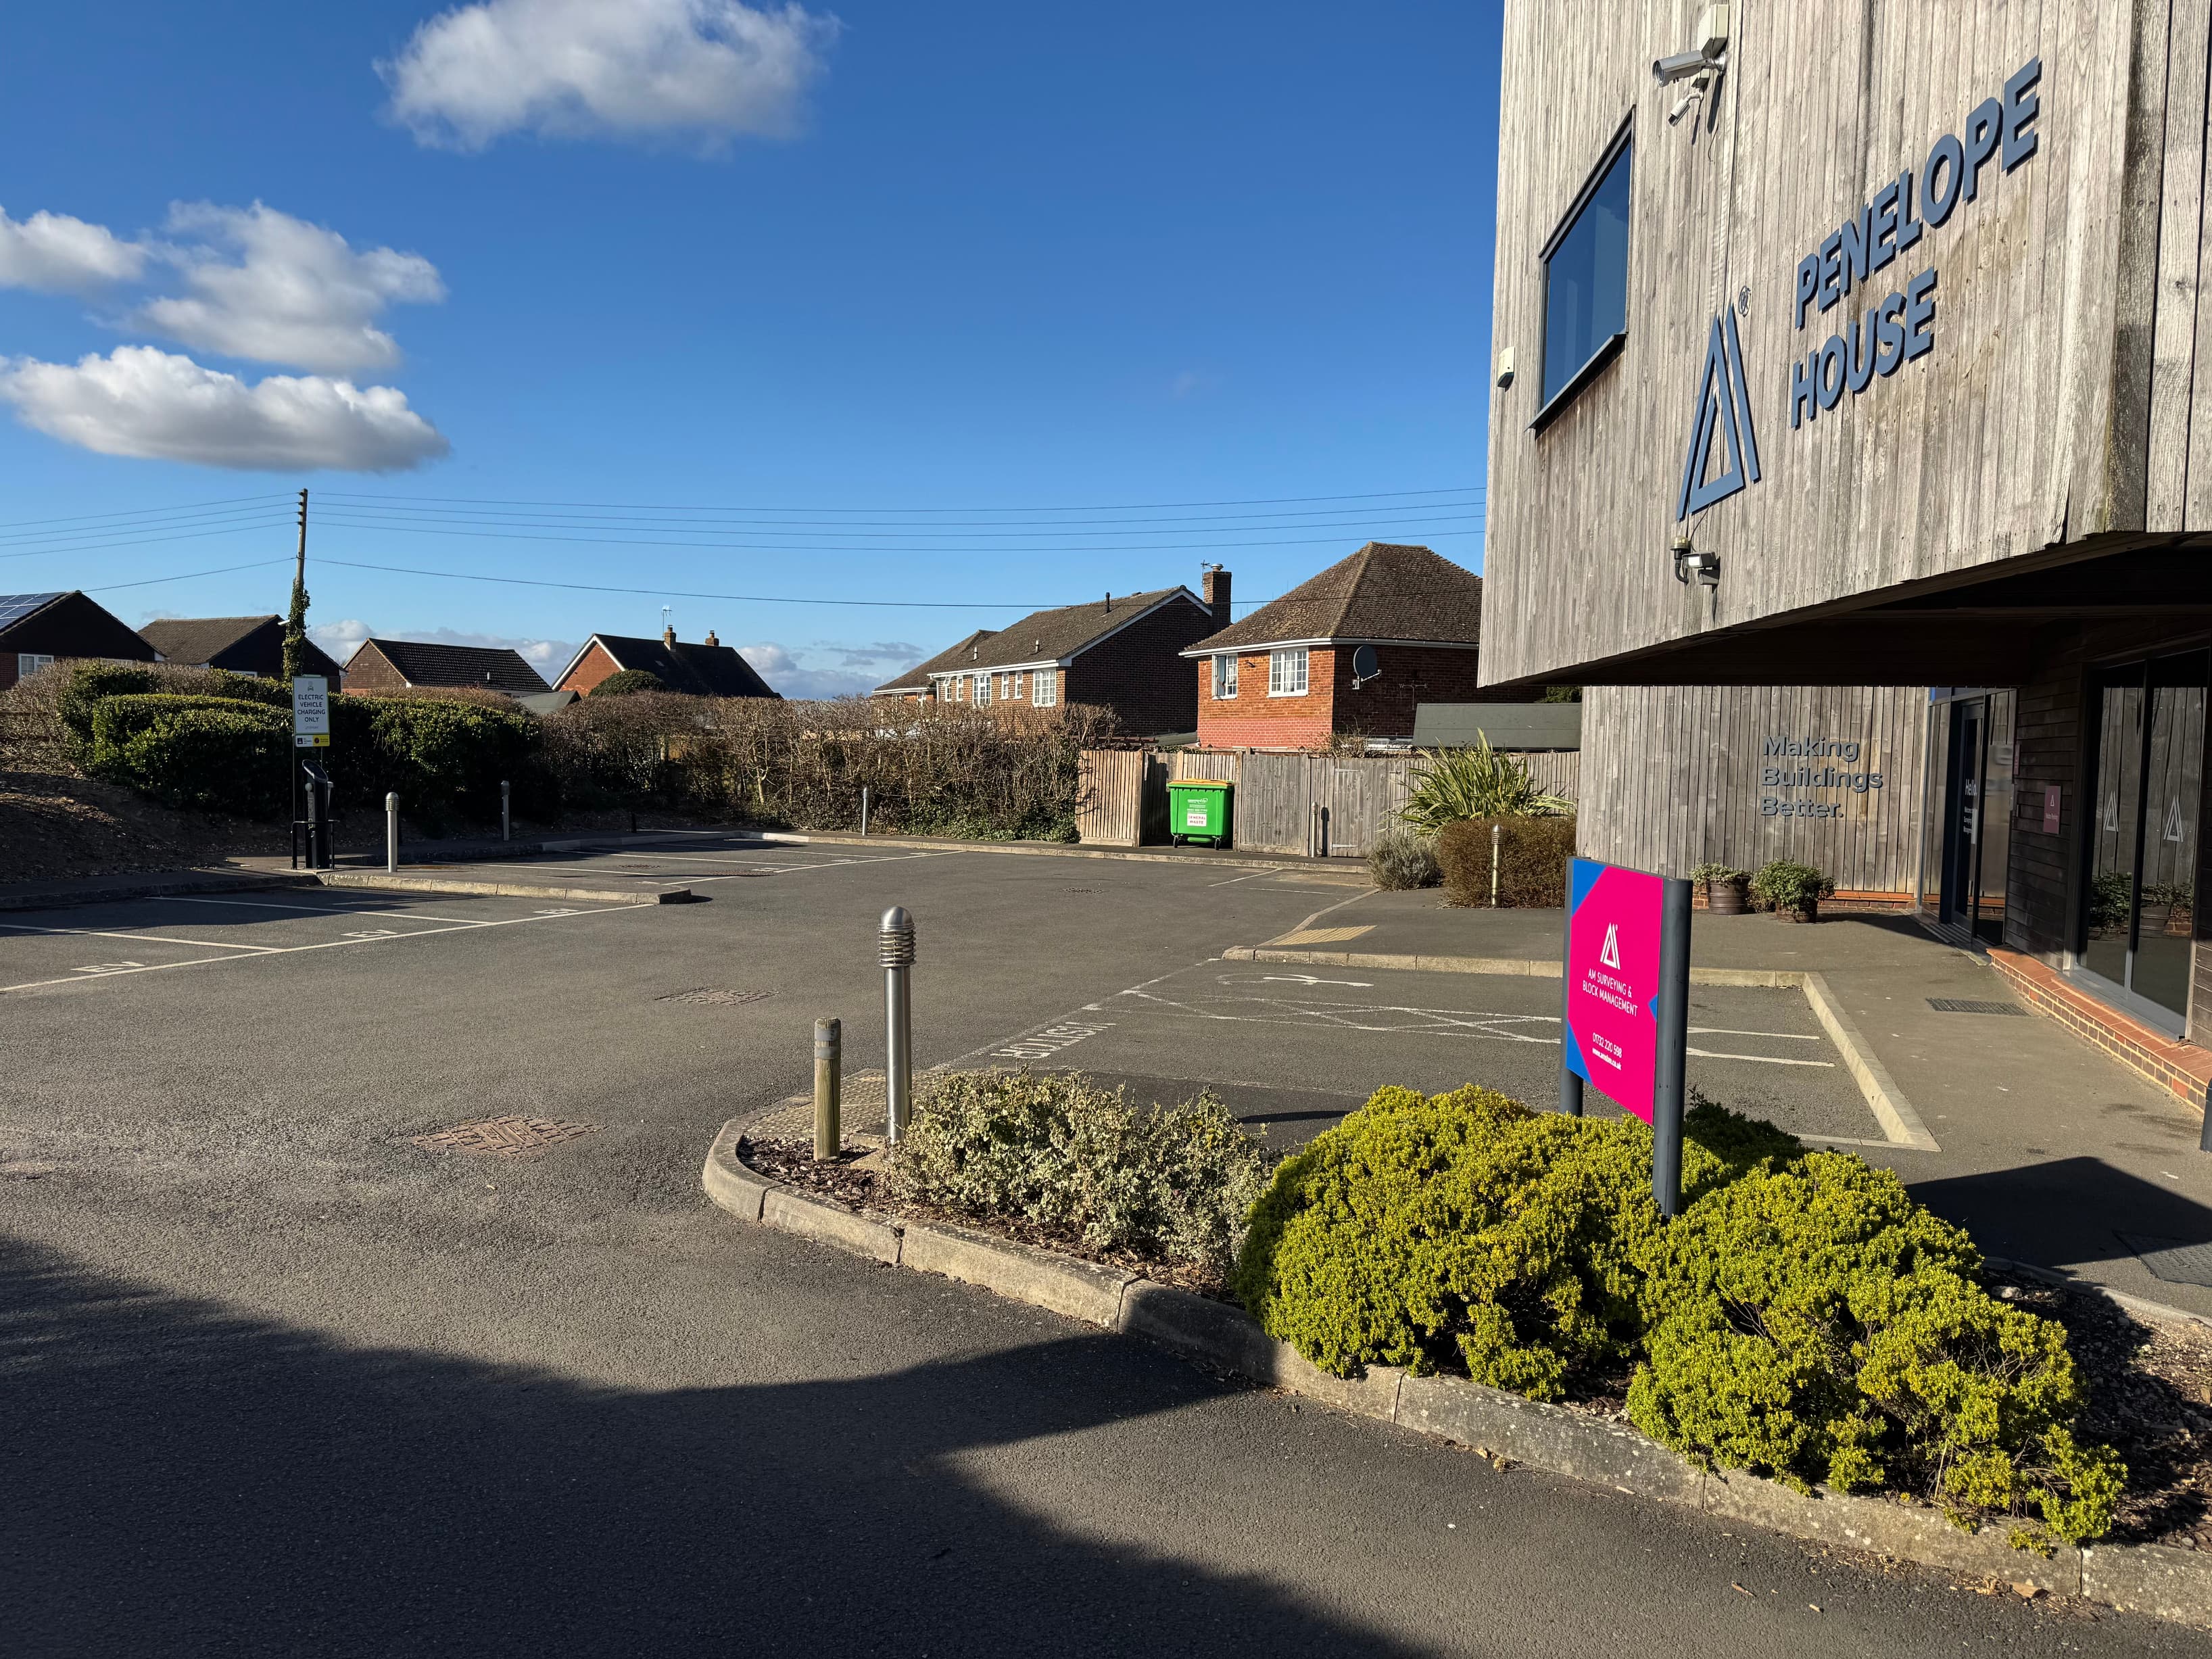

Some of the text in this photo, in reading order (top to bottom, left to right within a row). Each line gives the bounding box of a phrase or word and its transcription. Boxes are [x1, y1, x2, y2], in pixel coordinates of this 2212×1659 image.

[1795, 56, 2042, 330] PENELOPE
[1790, 266, 1938, 430] HOUSE
[1762, 736, 1859, 762] Making
[1761, 766, 1883, 792] Buildings
[1760, 796, 1844, 818] Better.
[340, 930, 398, 938] EV
[70, 961, 146, 972] EV
[1588, 967, 1632, 998] AM SURVEYING &
[1583, 980, 1638, 1017] BLOCK MANAGEMENT
[1592, 1032, 1604, 1048] 01732
[1604, 1039, 1613, 1053] 220
